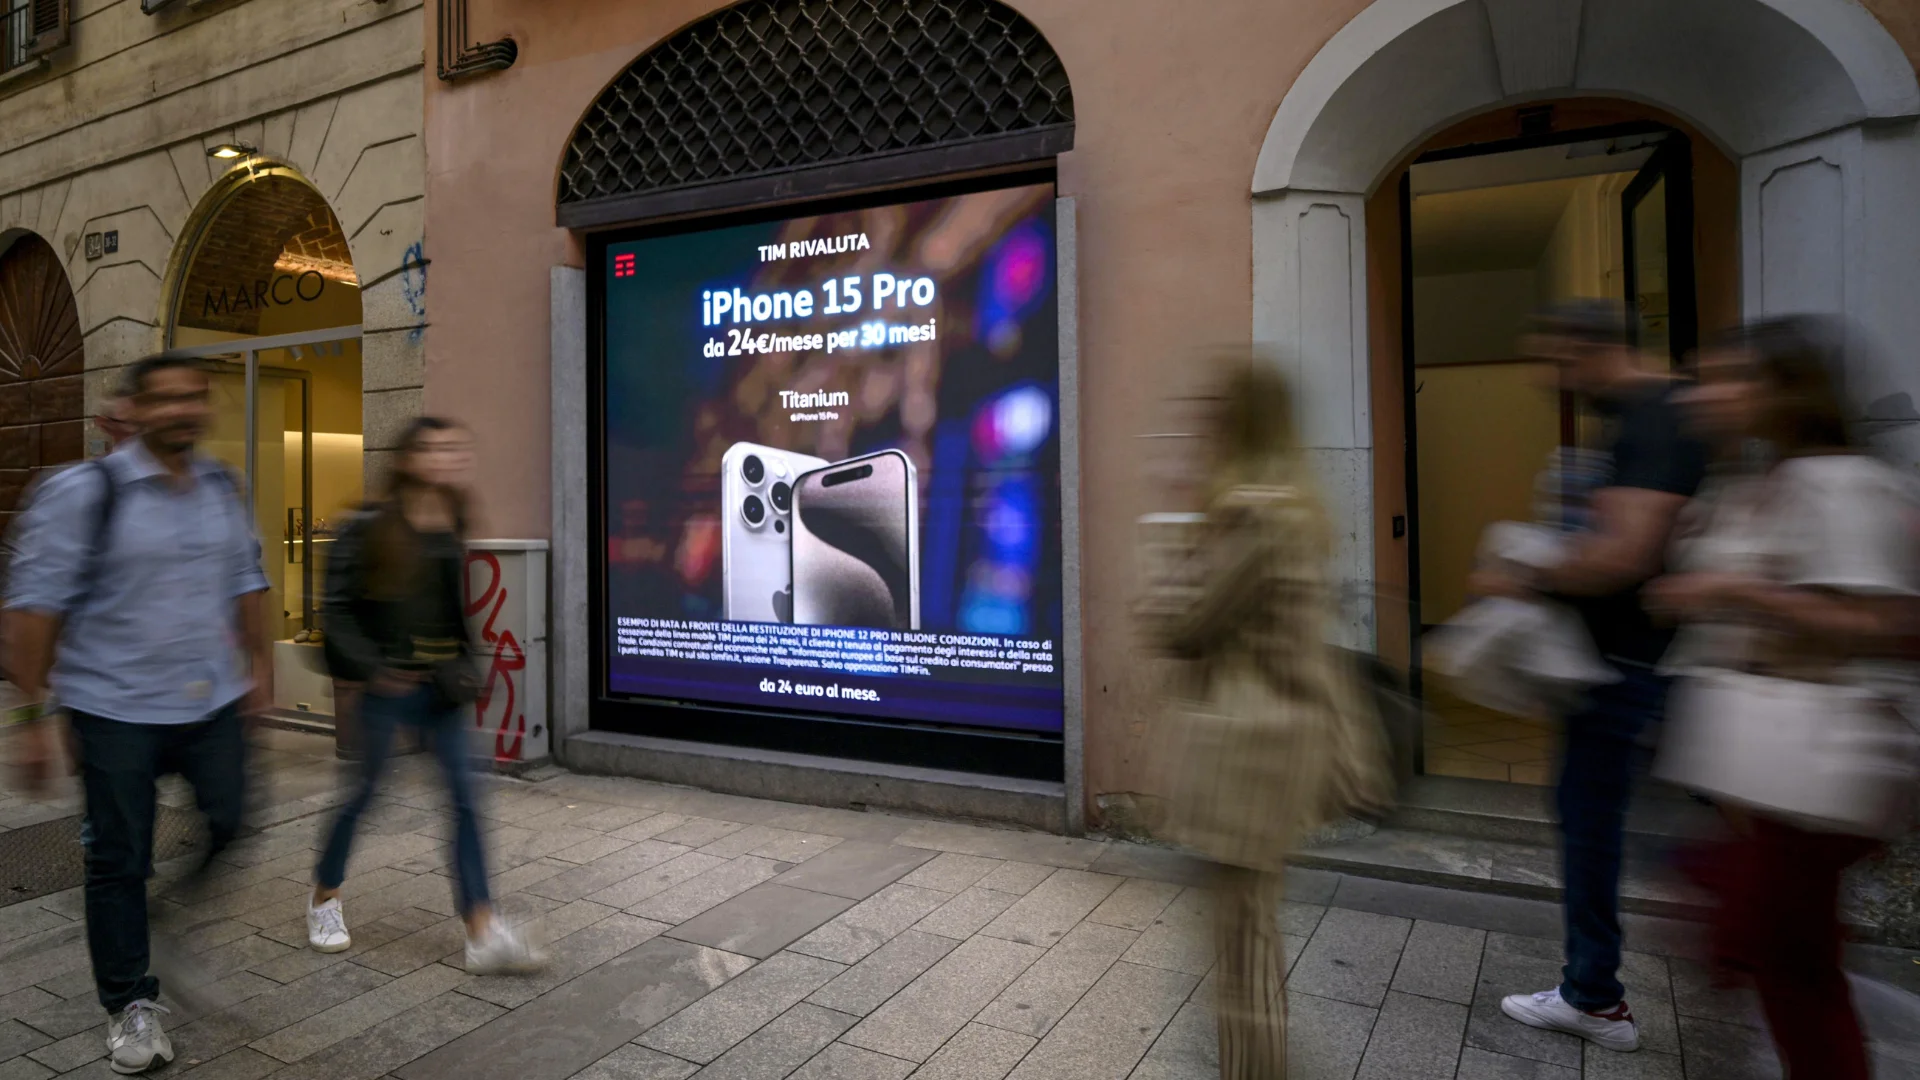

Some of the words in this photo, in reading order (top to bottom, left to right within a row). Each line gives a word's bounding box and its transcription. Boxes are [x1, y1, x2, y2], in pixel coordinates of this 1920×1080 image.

[758, 243, 786, 262] TIM
[789, 233, 870, 258] RIVALUTA
[203, 270, 324, 317] MARCO
[703, 287, 814, 326] iPhone
[822, 276, 862, 314] 15
[873, 273, 935, 310] Pro
[703, 337, 725, 358] da
[727, 328, 824, 356] 24€/mese
[827, 329, 859, 354] per
[860, 322, 885, 346] 30
[889, 318, 936, 344] mesi
[779, 389, 849, 409] Titanium
[617, 616, 649, 627] ESEMPIO
[650, 618, 659, 628] DI
[660, 619, 680, 629] RATA
[681, 620, 688, 629] A
[688, 621, 720, 632] FRONTE
[721, 622, 748, 633] DELLA
[749, 624, 809, 636] RESTITUZIONE
[810, 627, 821, 637] DI
[822, 628, 856, 639] IPHONE
[857, 630, 868, 640] 12
[870, 631, 889, 641] PRO
[891, 632, 901, 641] IN
[903, 632, 937, 644] BUONE
[939, 634, 1002, 648] CONDIZIONI.
[1003, 638, 1014, 648] In
[1016, 640, 1040, 650] caso
[1042, 639, 1052, 650] di
[617, 628, 653, 637] cessazione
[655, 629, 672, 639] della
[673, 630, 690, 640] linea
[691, 632, 716, 642] mobile
[717, 632, 731, 642] TIM
[732, 634, 755, 644] prima
[755, 635, 768, 644] dei
[768, 636, 778, 645] 24
[801, 637, 807, 647] il
[808, 638, 836, 649] cliente
[843, 641, 873, 651] tenuto
[873, 642, 882, 651] al
[883, 644, 933, 655] pagamento
[934, 646, 956, 657] degli
[957, 646, 997, 658] interessi
[998, 650, 1005, 658] e
[1006, 649, 1031, 660] della
[1032, 652, 1053, 661] rata
[621, 646, 639, 656] punti
[639, 647, 664, 657] vendita
[665, 648, 678, 658] TIM
[679, 650, 685, 659] e
[685, 651, 696, 660] sul
[696, 652, 710, 661] sito
[742, 655, 771, 665] sezione
[821, 659, 843, 670] Salvo
[844, 662, 899, 673] approvazione
[638, 638, 672, 648] Condizioni
[673, 641, 713, 651] contrattuali
[713, 643, 723, 652] ed
[724, 644, 769, 655] economiche
[768, 646, 788, 656] nelle
[840, 652, 874, 662] europee
[874, 652, 883, 662] di
[884, 652, 904, 663] base
[905, 655, 918, 664] sul
[919, 656, 949, 666] credito
[950, 657, 959, 667] ai
[1022, 663, 1054, 674] presso
[759, 677, 776, 693] da
[777, 679, 793, 695] 24
[794, 683, 824, 697] euro
[826, 683, 839, 699] al
[841, 687, 881, 702] mese.
